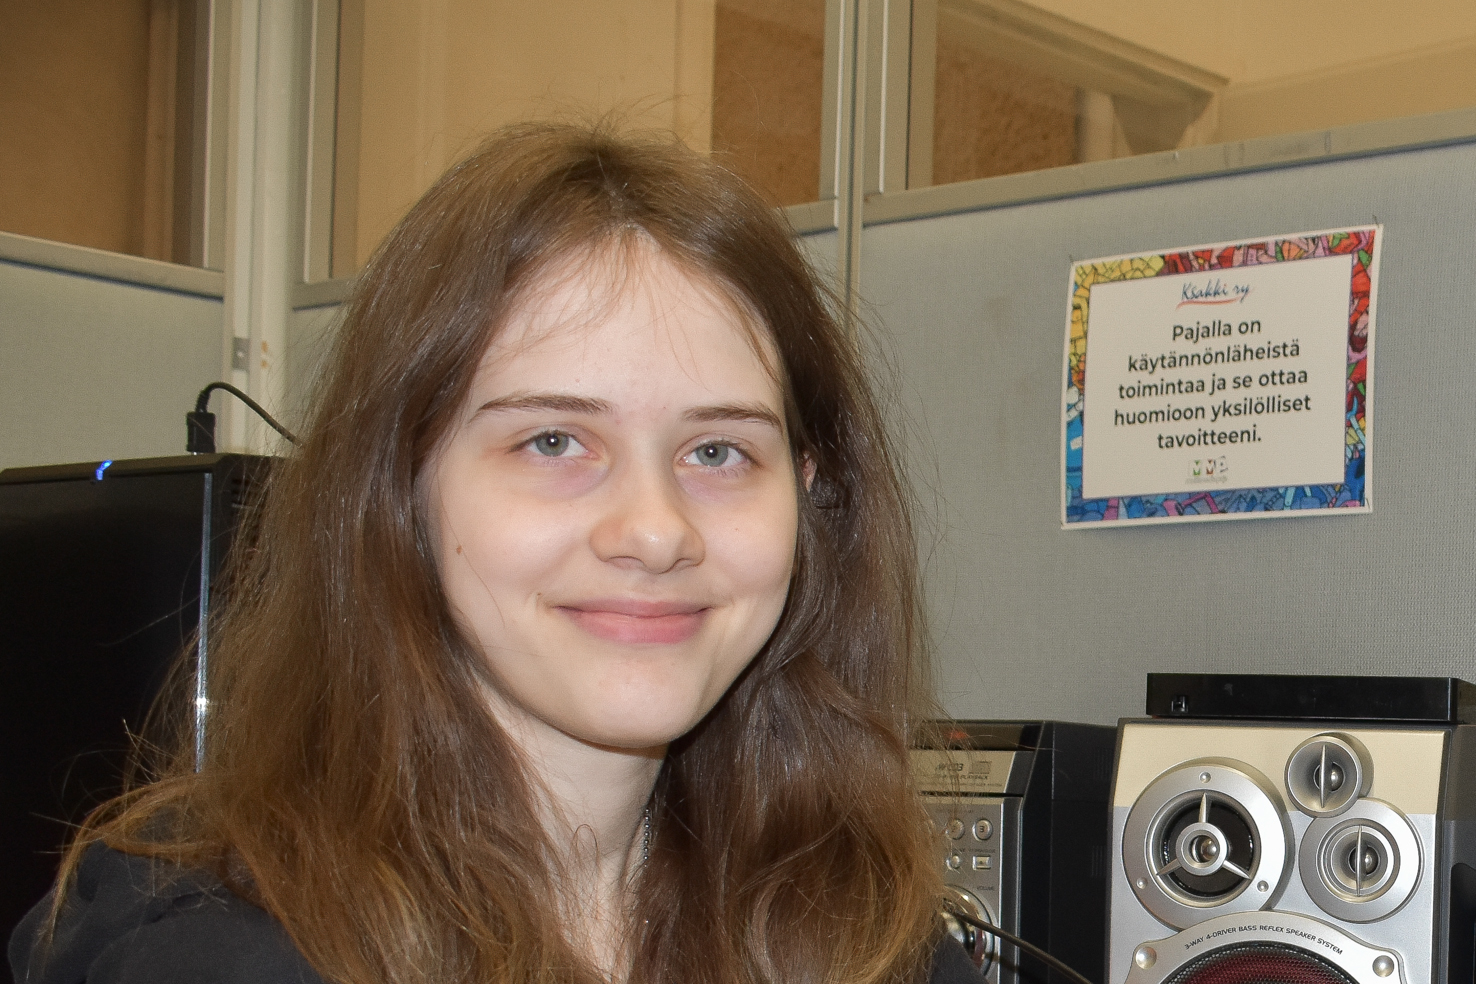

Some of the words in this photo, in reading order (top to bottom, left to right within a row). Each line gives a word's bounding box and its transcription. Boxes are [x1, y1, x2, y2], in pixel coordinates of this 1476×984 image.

[1233, 284, 1250, 303] ry
[1172, 319, 1232, 343] Pajalla
[1238, 319, 1261, 334] on
[1128, 339, 1300, 374] käytännönläheistä
[1119, 373, 1205, 399] toimintaa
[1209, 373, 1226, 395] ja
[1232, 374, 1252, 389] se
[1259, 368, 1308, 388] ottaa
[1114, 404, 1205, 426] huomioon
[1211, 394, 1311, 422] yksilölliset
[1157, 424, 1262, 449] tavoitteeni.
[979, 825, 985, 833] 3
[1184, 936, 1204, 950] 3-WAY
[1206, 927, 1236, 940] 4-DRIVER
[1259, 925, 1284, 933] REFLEX
[1286, 928, 1316, 942] SPEAKER
[1317, 937, 1343, 955] SYSTEM
